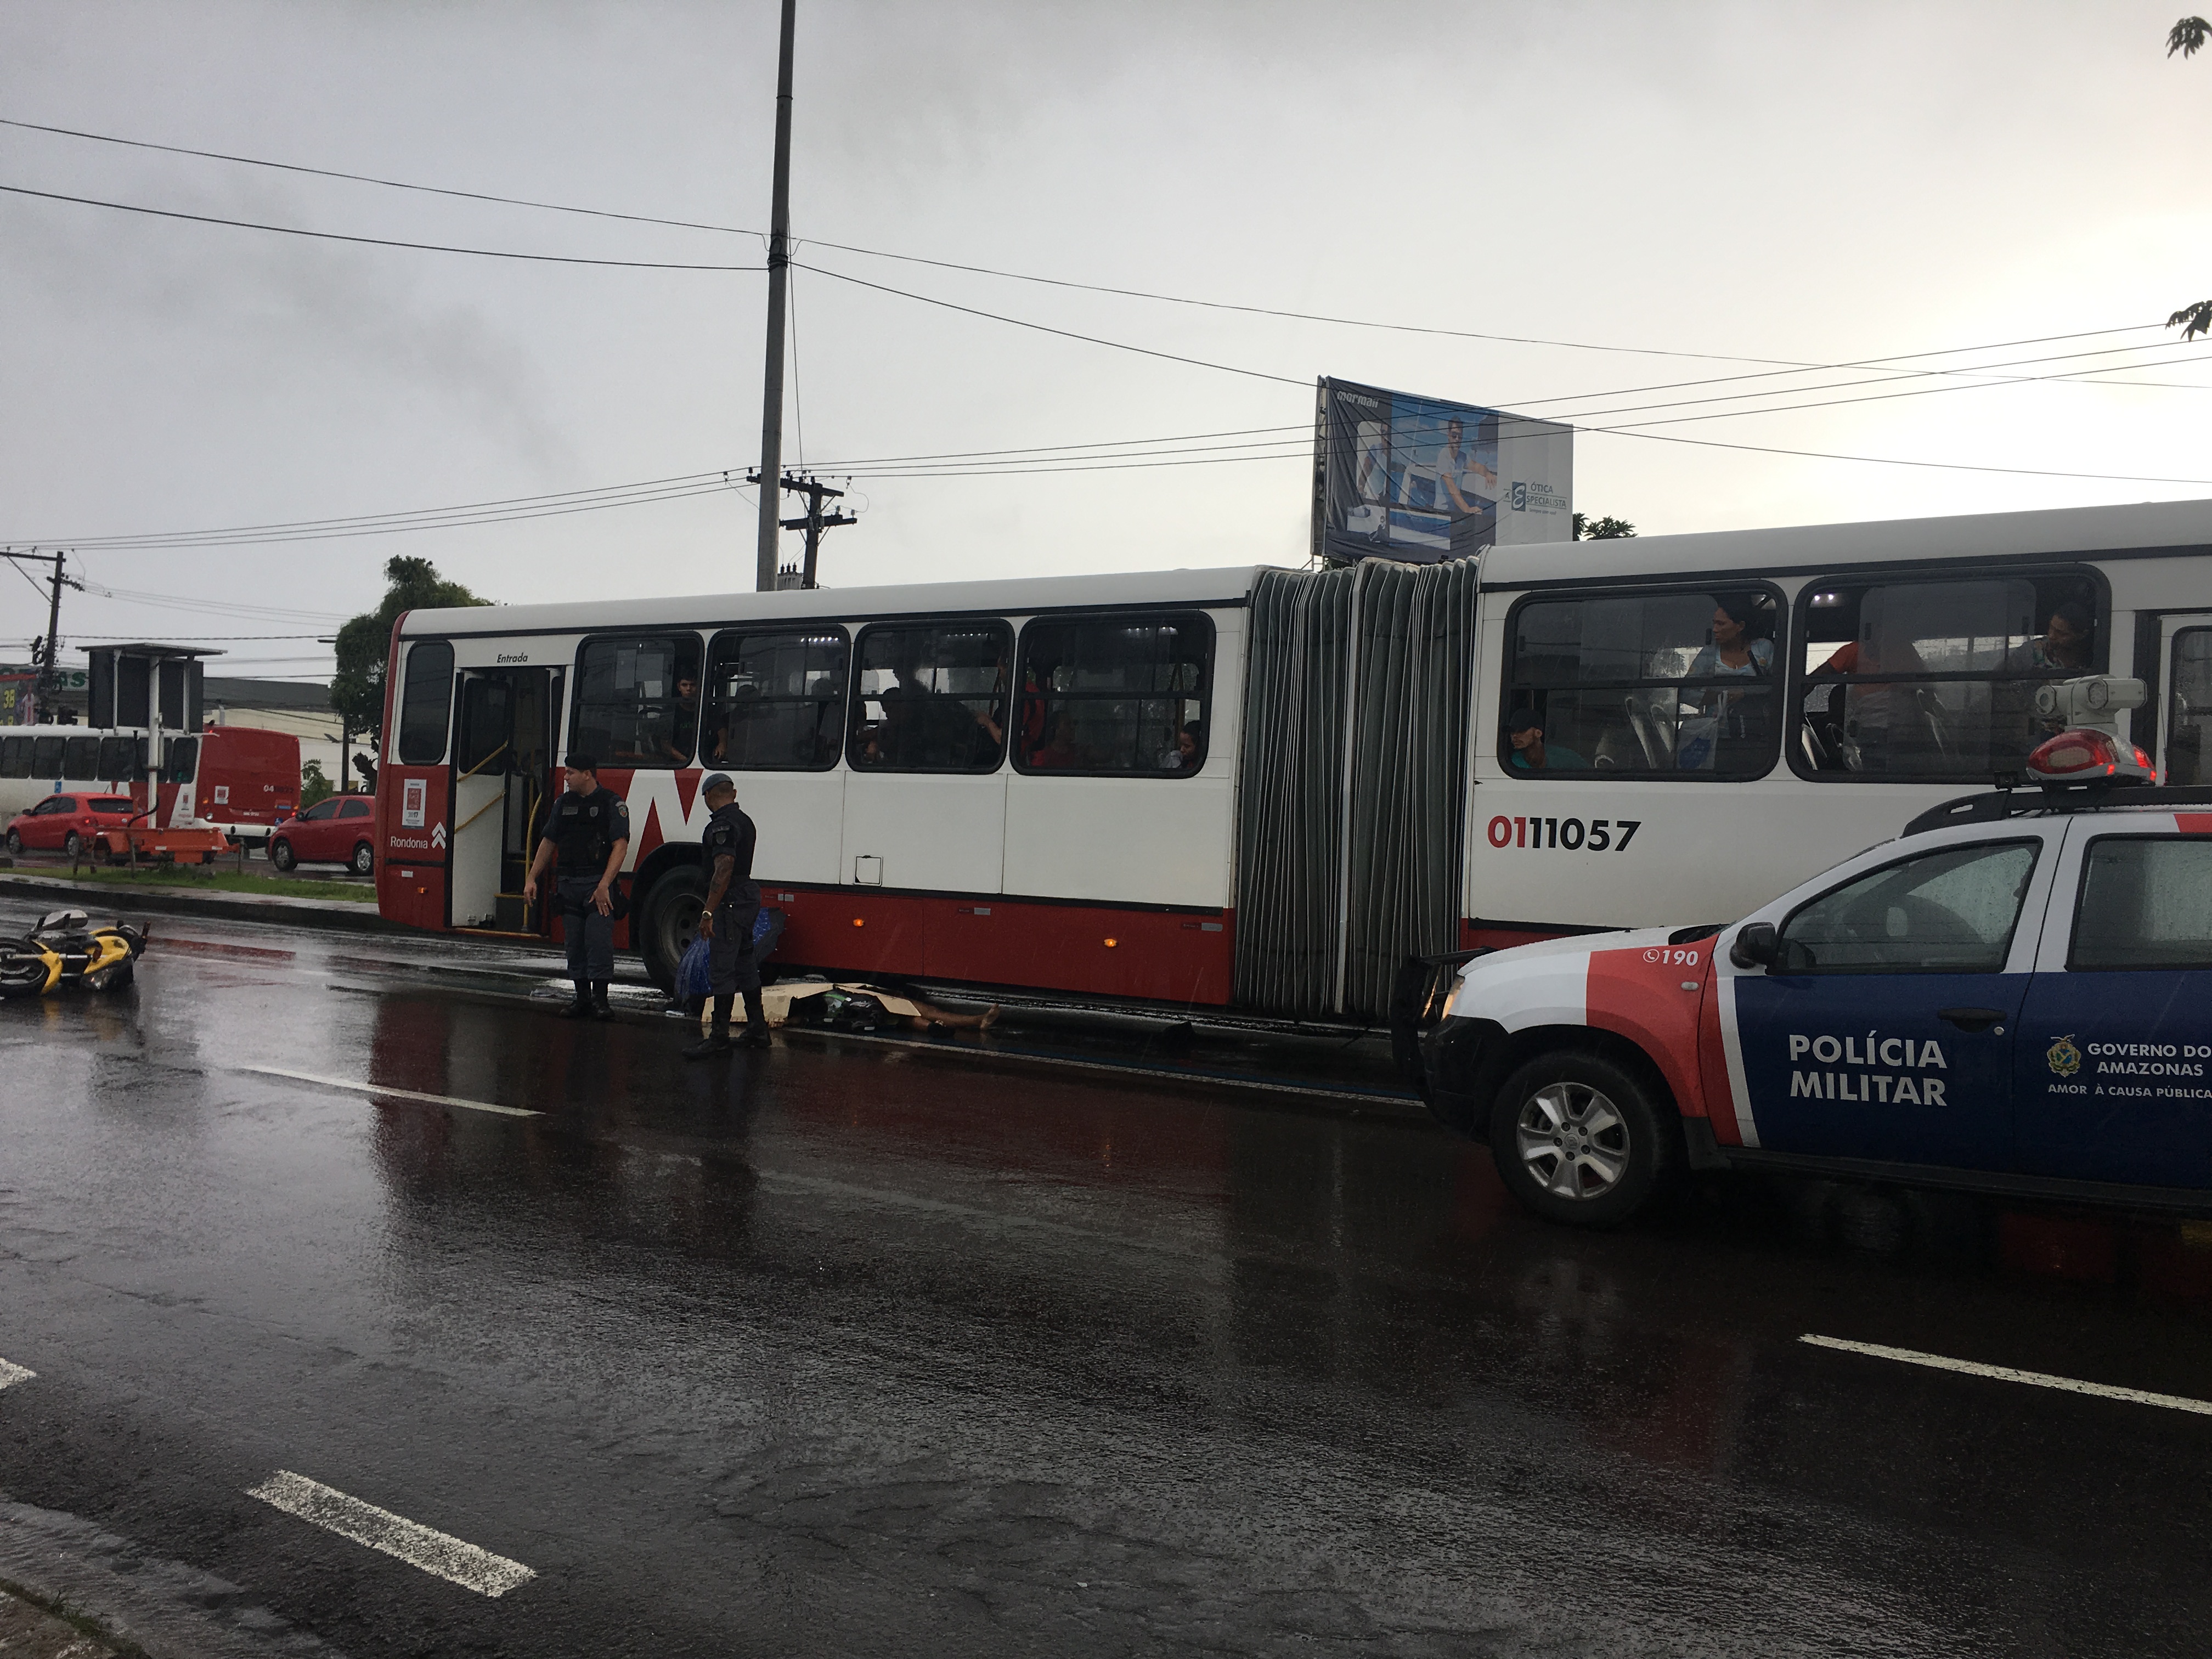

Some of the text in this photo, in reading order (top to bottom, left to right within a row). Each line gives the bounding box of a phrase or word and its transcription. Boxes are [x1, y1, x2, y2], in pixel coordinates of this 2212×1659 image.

[1337, 390, 1379, 408] mormaii
[1531, 481, 1553, 493] ÓTICA
[497, 652, 528, 663] Entrada
[1487, 815, 1641, 851] 0111057
[1662, 950, 1699, 966] 190
[1789, 1030, 1947, 1069] POLÍCIA
[2087, 1043, 2211, 1058] GOVERNO DO
[2097, 1062, 2203, 1076] AMAZONAS
[1790, 1071, 1947, 1106] MILITAR
[2048, 1083, 2212, 1098] AMOR À CAUSA PÚBLICA
